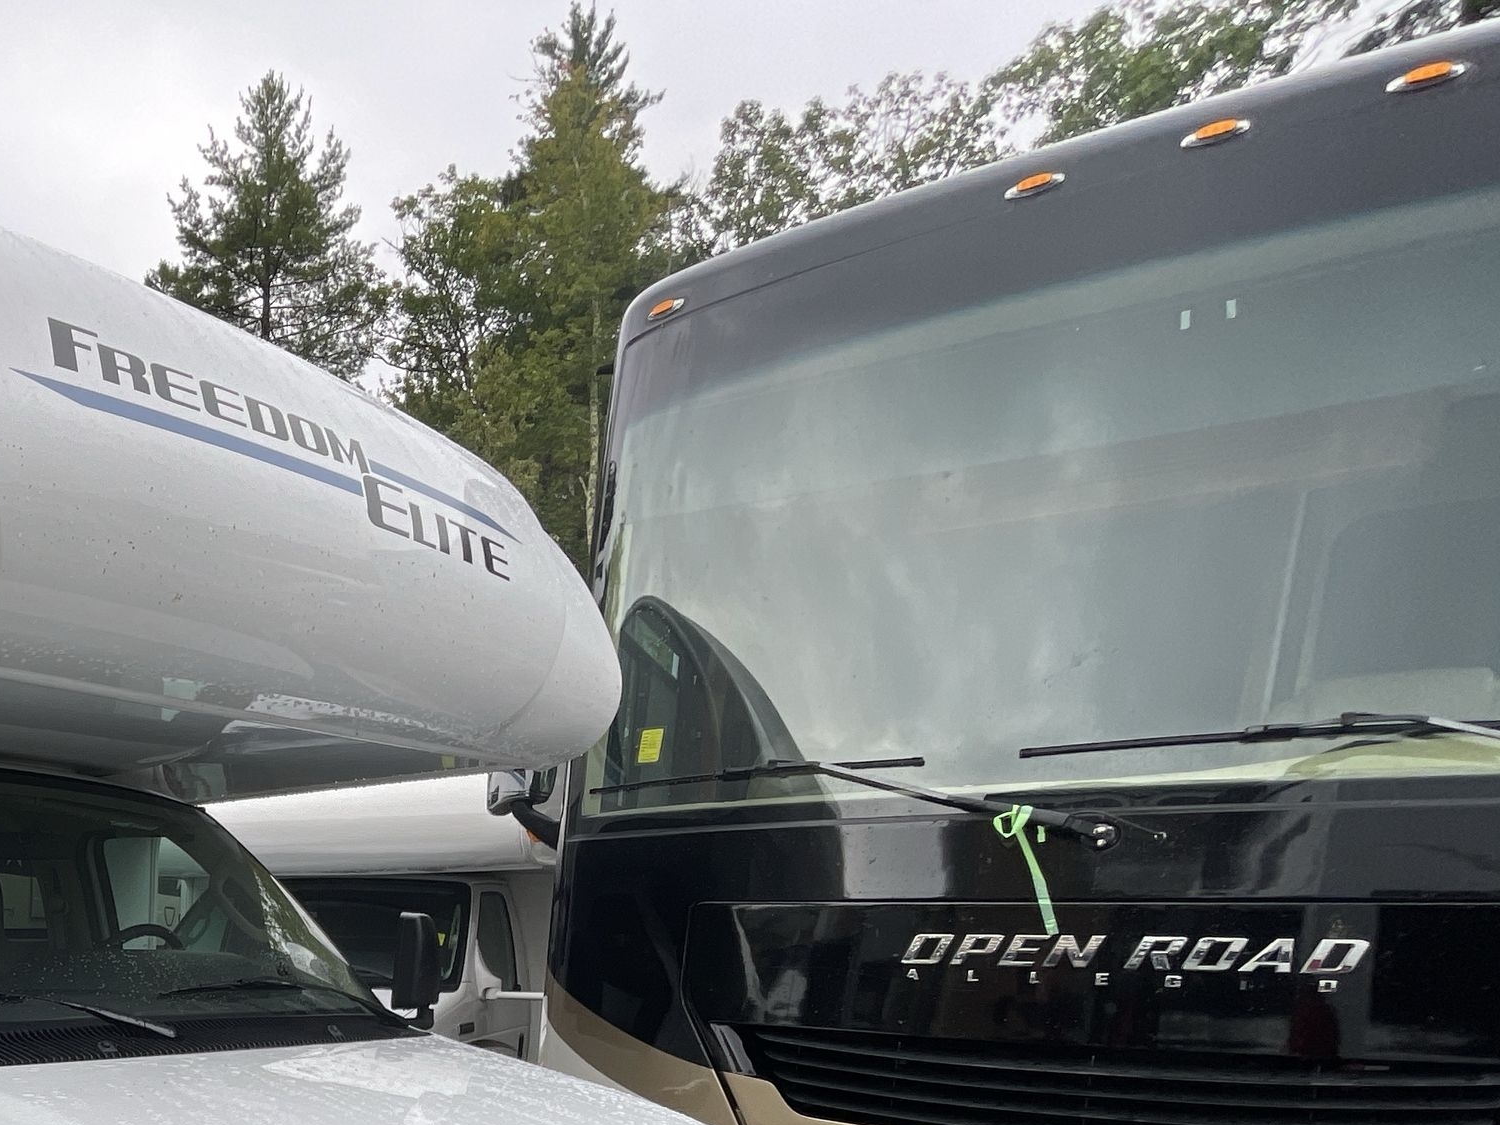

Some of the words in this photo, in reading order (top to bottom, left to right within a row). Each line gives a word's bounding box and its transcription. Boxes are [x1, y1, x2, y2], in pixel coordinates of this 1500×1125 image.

[47, 316, 371, 474] FREEDOM
[362, 473, 512, 582] ELITE
[900, 933, 1108, 968] OPEN
[1122, 935, 1371, 974] ROAD
